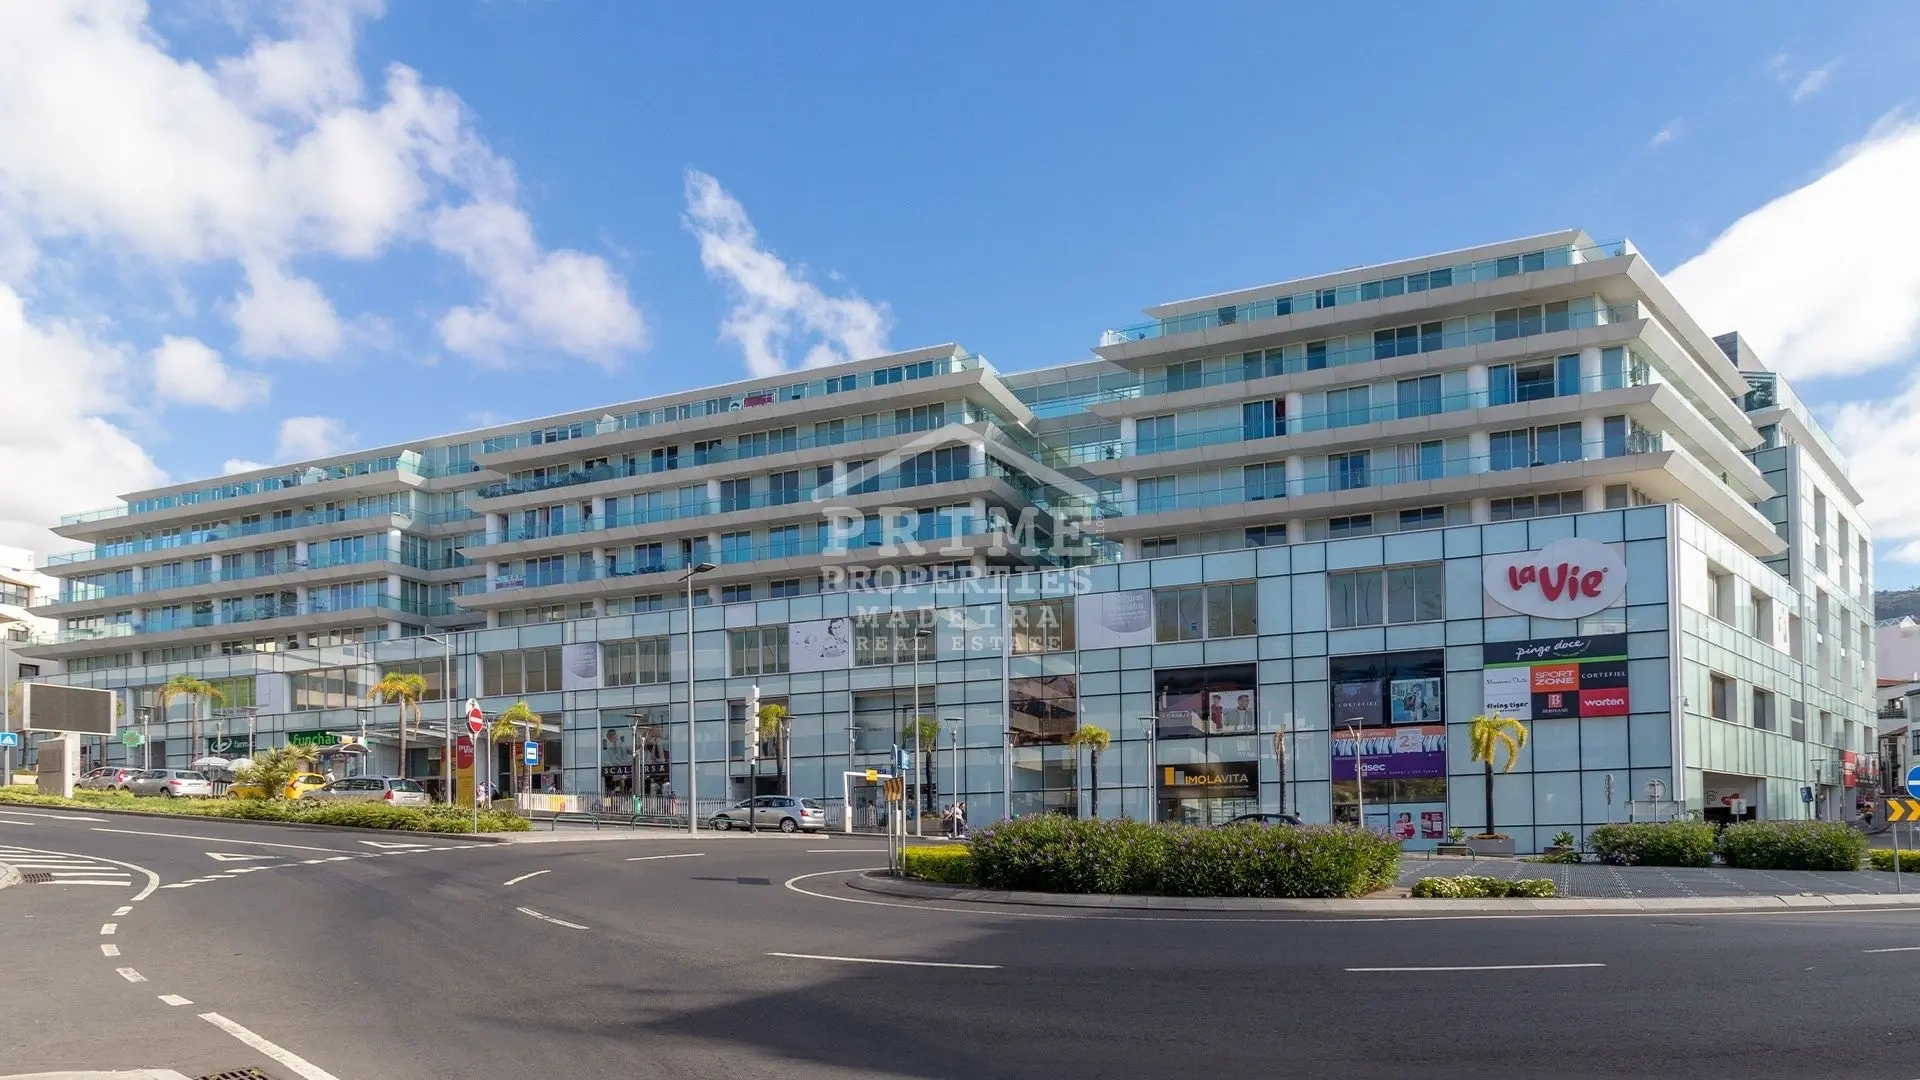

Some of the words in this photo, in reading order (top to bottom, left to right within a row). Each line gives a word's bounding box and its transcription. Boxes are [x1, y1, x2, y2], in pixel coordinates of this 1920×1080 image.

[1515, 645, 1551, 661] pingo
[1553, 639, 1584, 650] doce
[1535, 669, 1574, 680] SPORT
[1581, 671, 1627, 679] CORTEFIEL
[1535, 677, 1575, 686] ZONE
[1584, 698, 1625, 707] worten
[1185, 774, 1249, 785] IMOLAVITA
